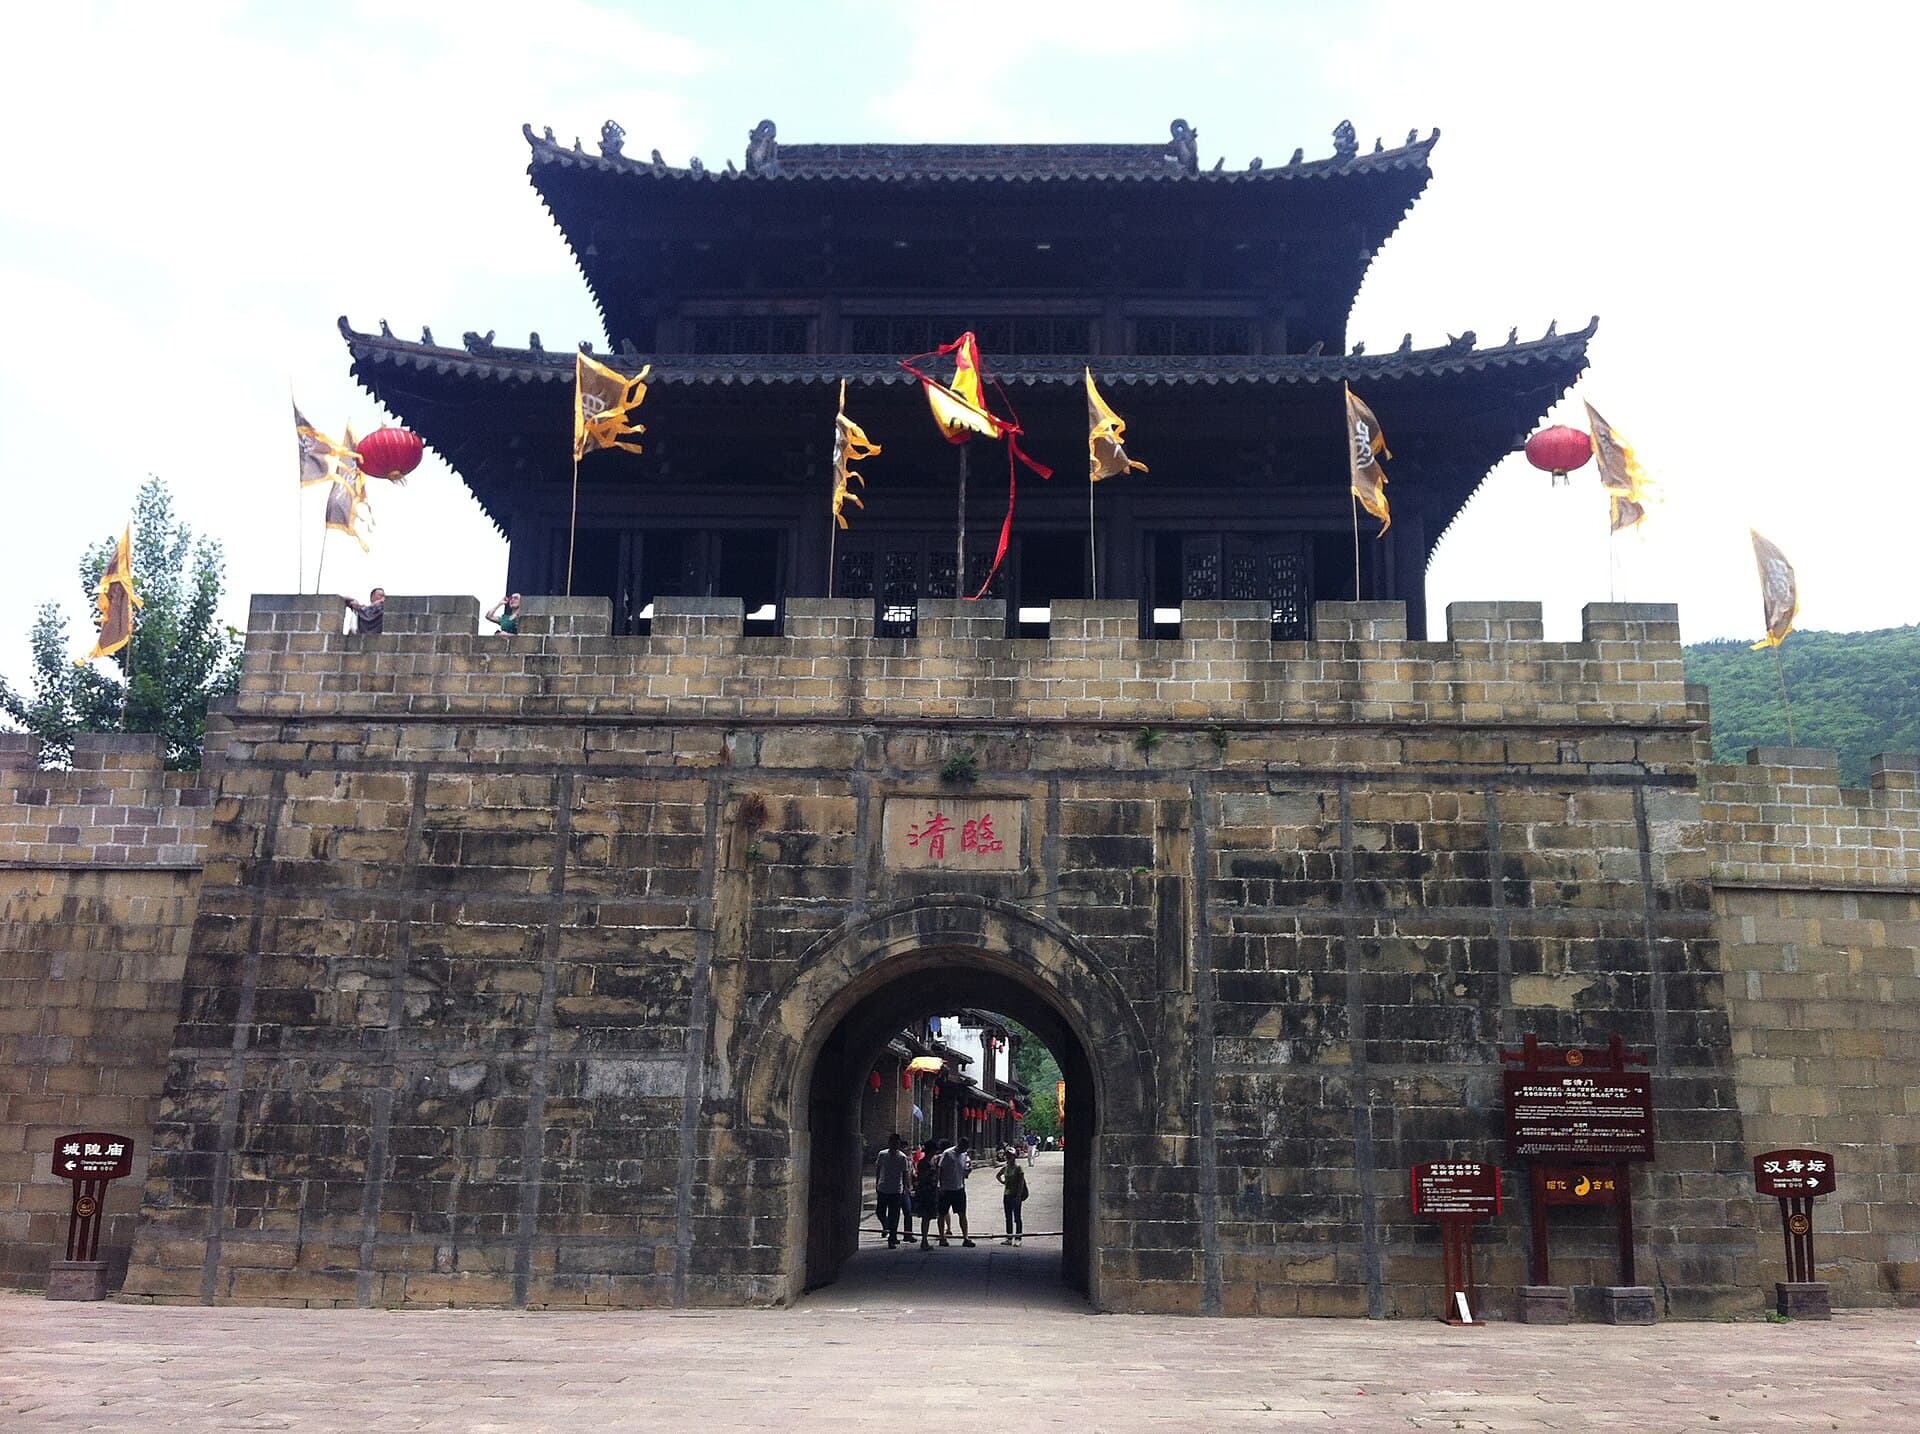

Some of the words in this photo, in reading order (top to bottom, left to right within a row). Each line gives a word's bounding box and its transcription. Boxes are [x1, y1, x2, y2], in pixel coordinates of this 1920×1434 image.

[62, 1142, 125, 1156] 城隍庙
[1763, 1160, 1826, 1173] 汉寿坛
